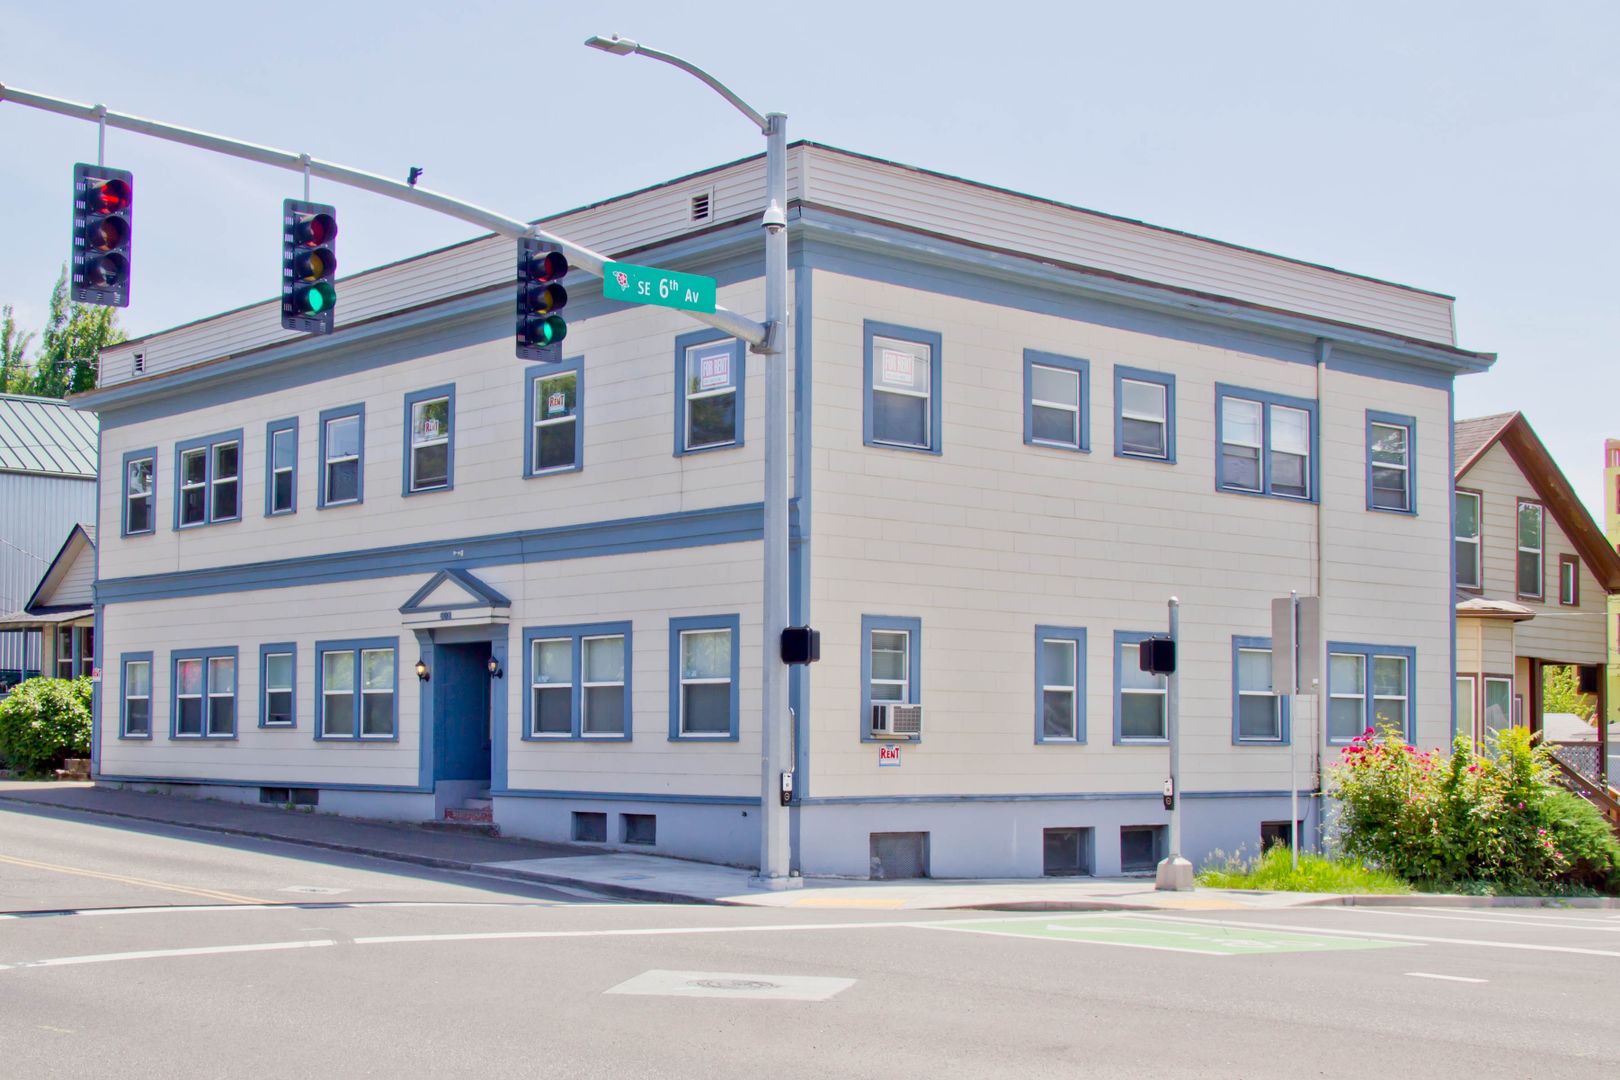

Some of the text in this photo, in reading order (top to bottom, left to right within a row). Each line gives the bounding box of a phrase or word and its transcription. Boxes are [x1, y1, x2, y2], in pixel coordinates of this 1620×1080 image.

[638, 280, 651, 296] SE
[659, 278, 679, 299] 6th
[880, 747, 900, 759] RENT
